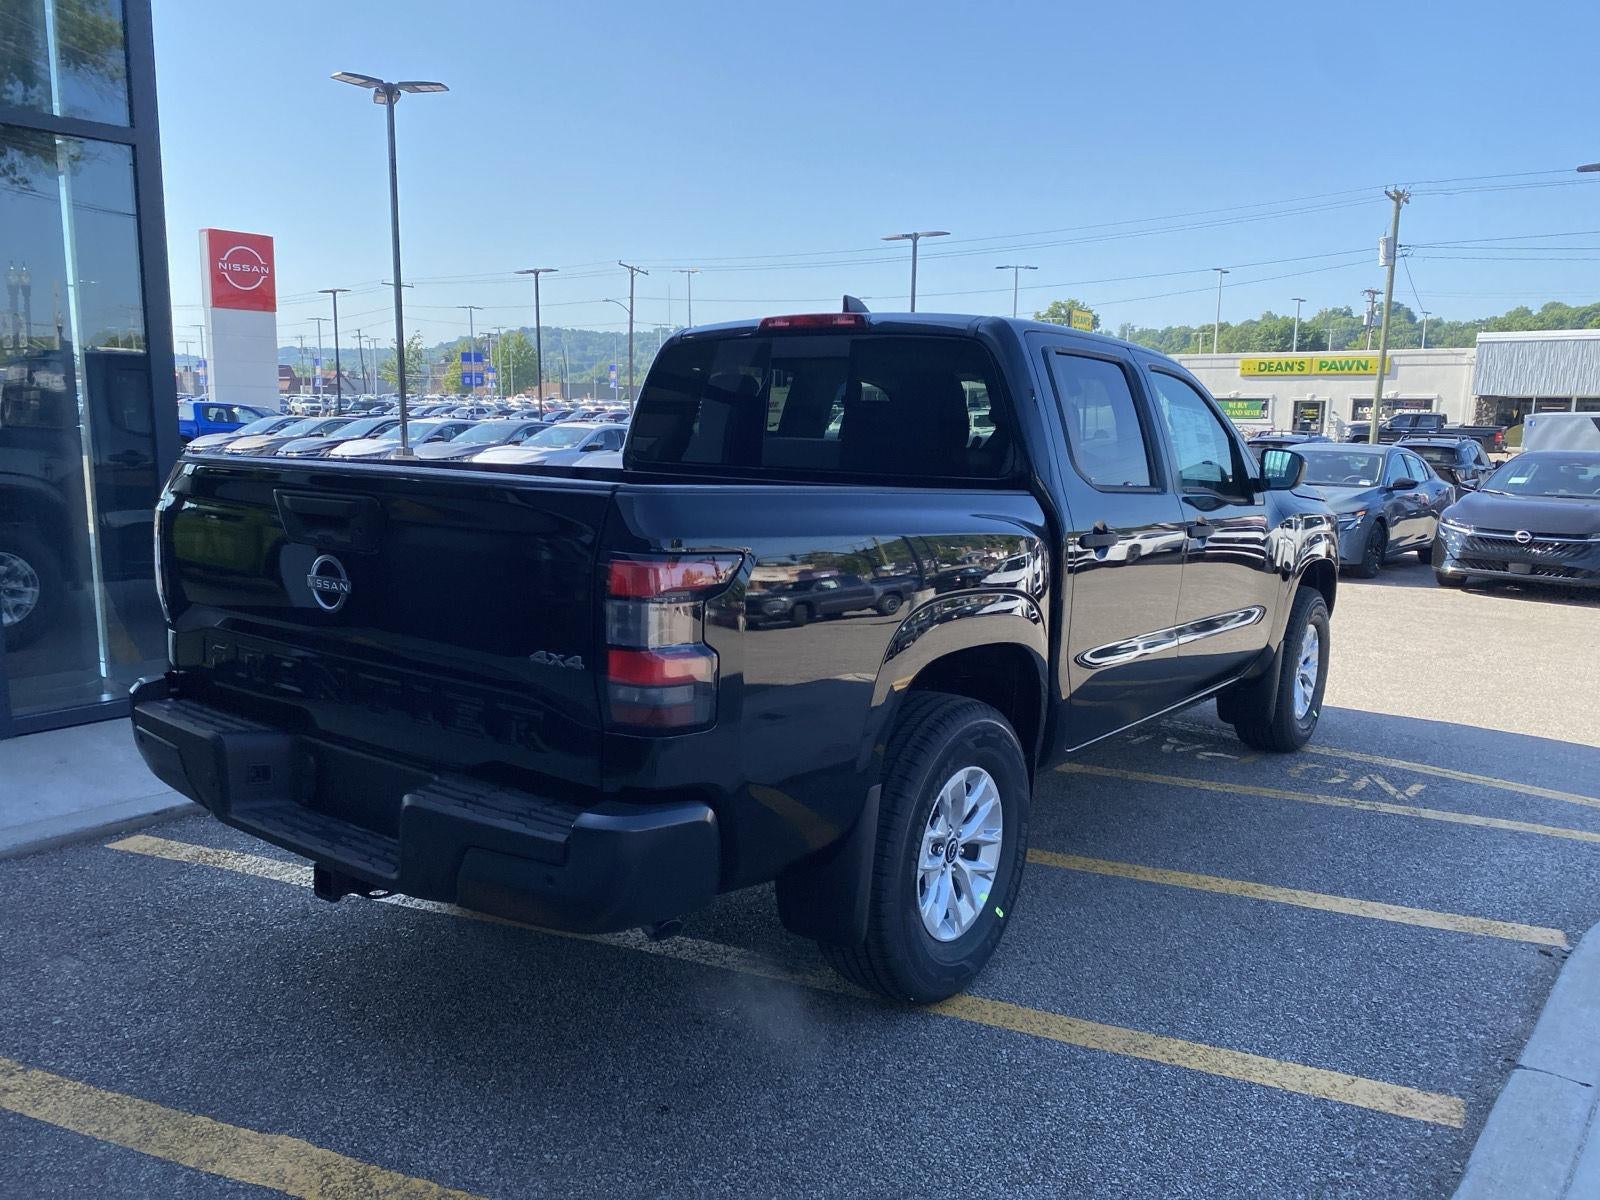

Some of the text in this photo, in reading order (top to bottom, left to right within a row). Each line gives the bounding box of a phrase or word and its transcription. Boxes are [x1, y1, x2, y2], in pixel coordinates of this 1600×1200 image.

[218, 262, 269, 274] NISSAN
[1257, 360, 1369, 372] DEAN'S PAWN
[307, 577, 348, 592] NISSAN
